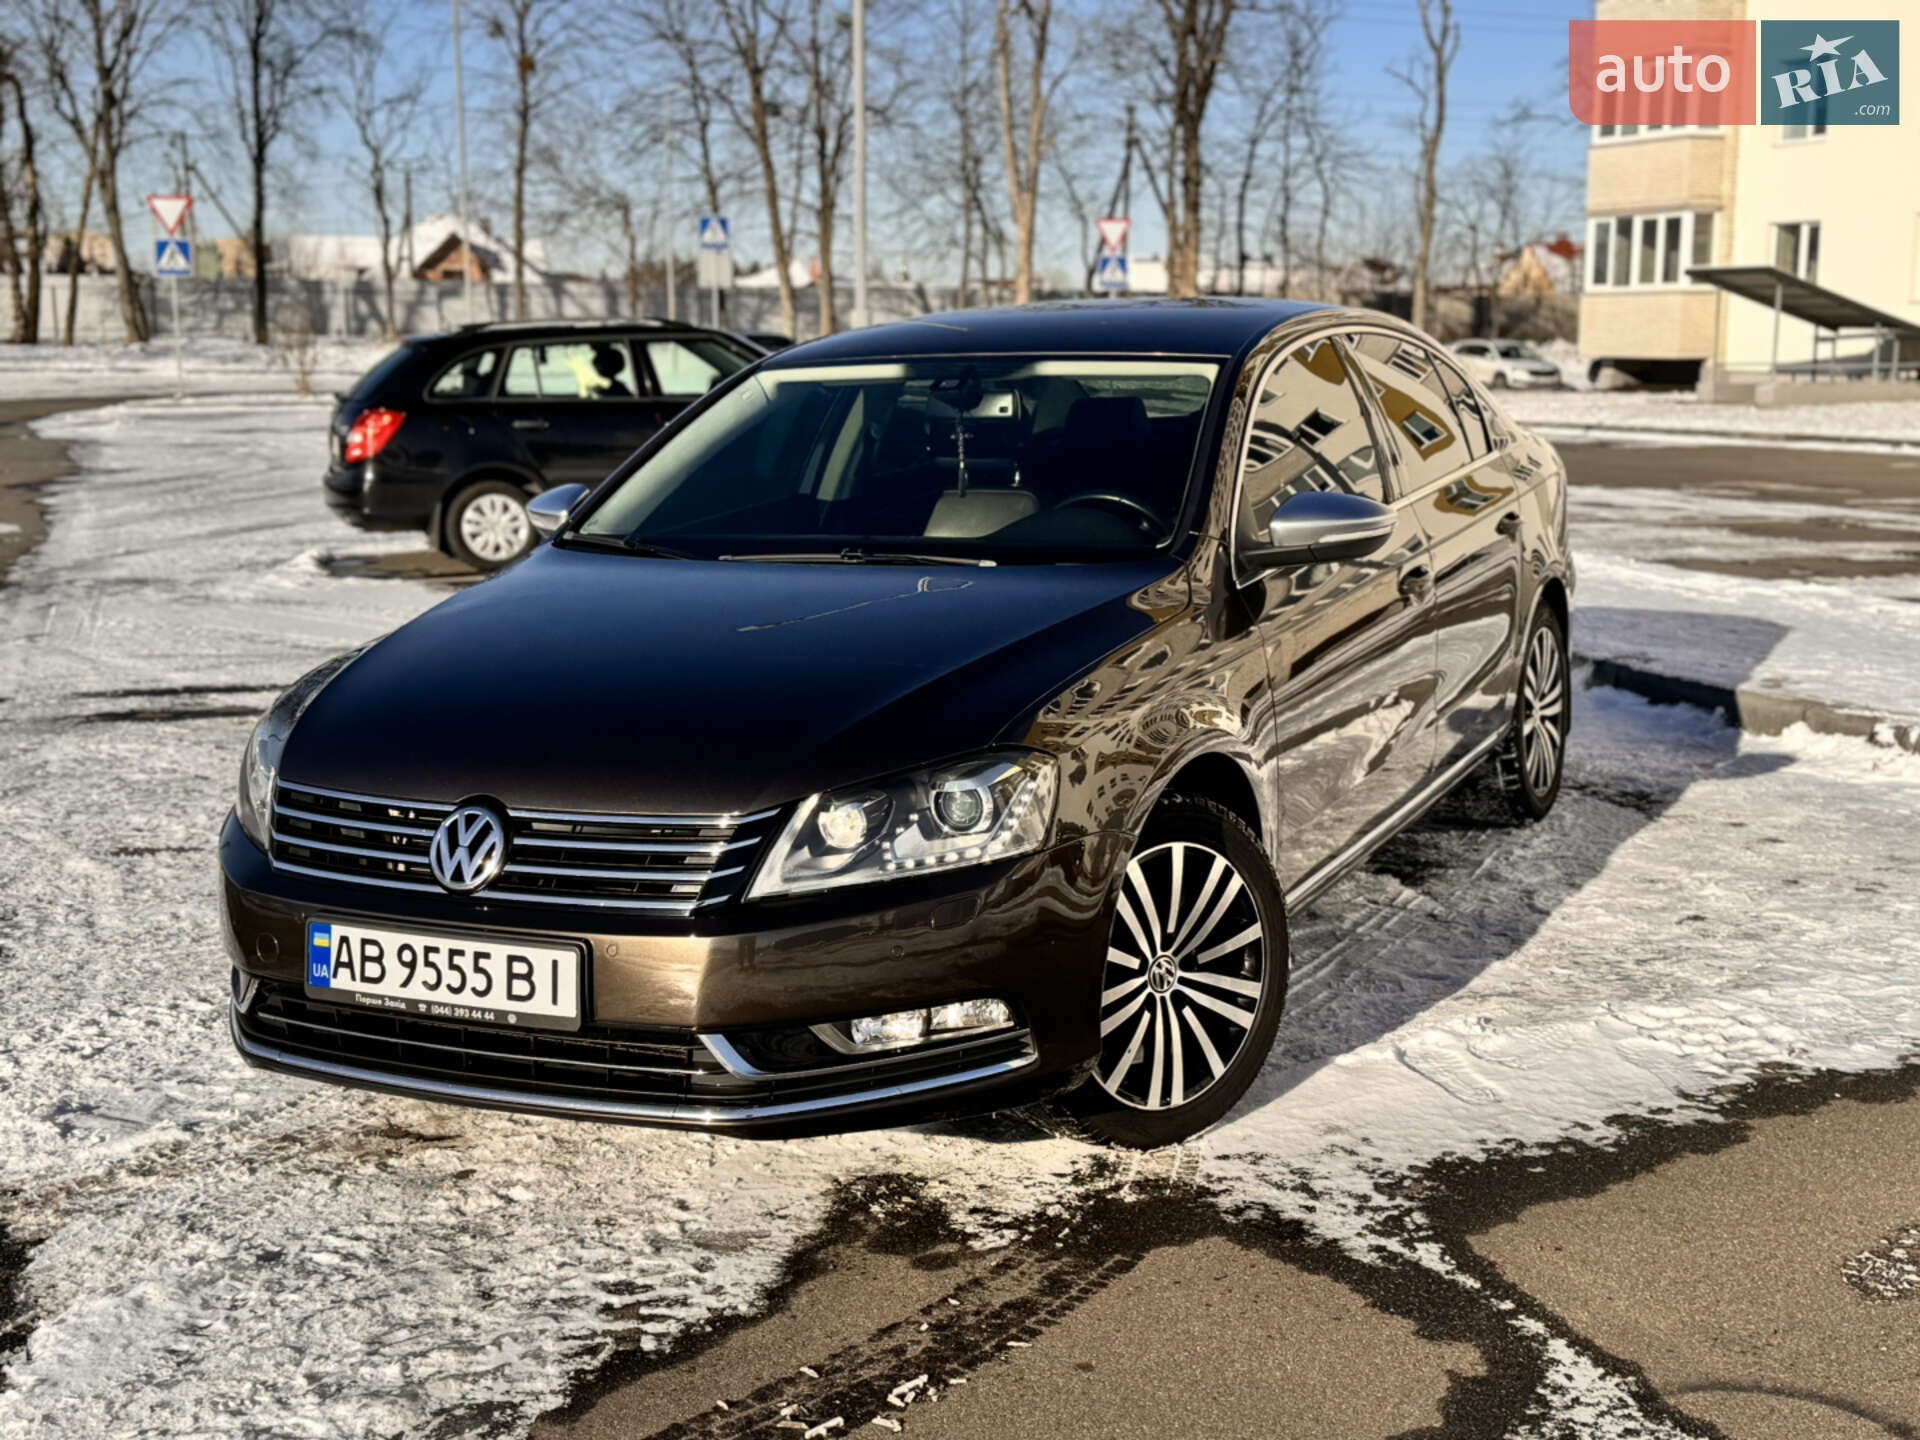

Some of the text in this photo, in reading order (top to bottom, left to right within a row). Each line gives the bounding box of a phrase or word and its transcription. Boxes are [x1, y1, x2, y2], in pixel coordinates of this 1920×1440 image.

[313, 963, 329, 979] UA
[332, 935, 559, 1006] AB 9555 BI
[471, 1009, 482, 1018] 44
[484, 1011, 495, 1020] 44
